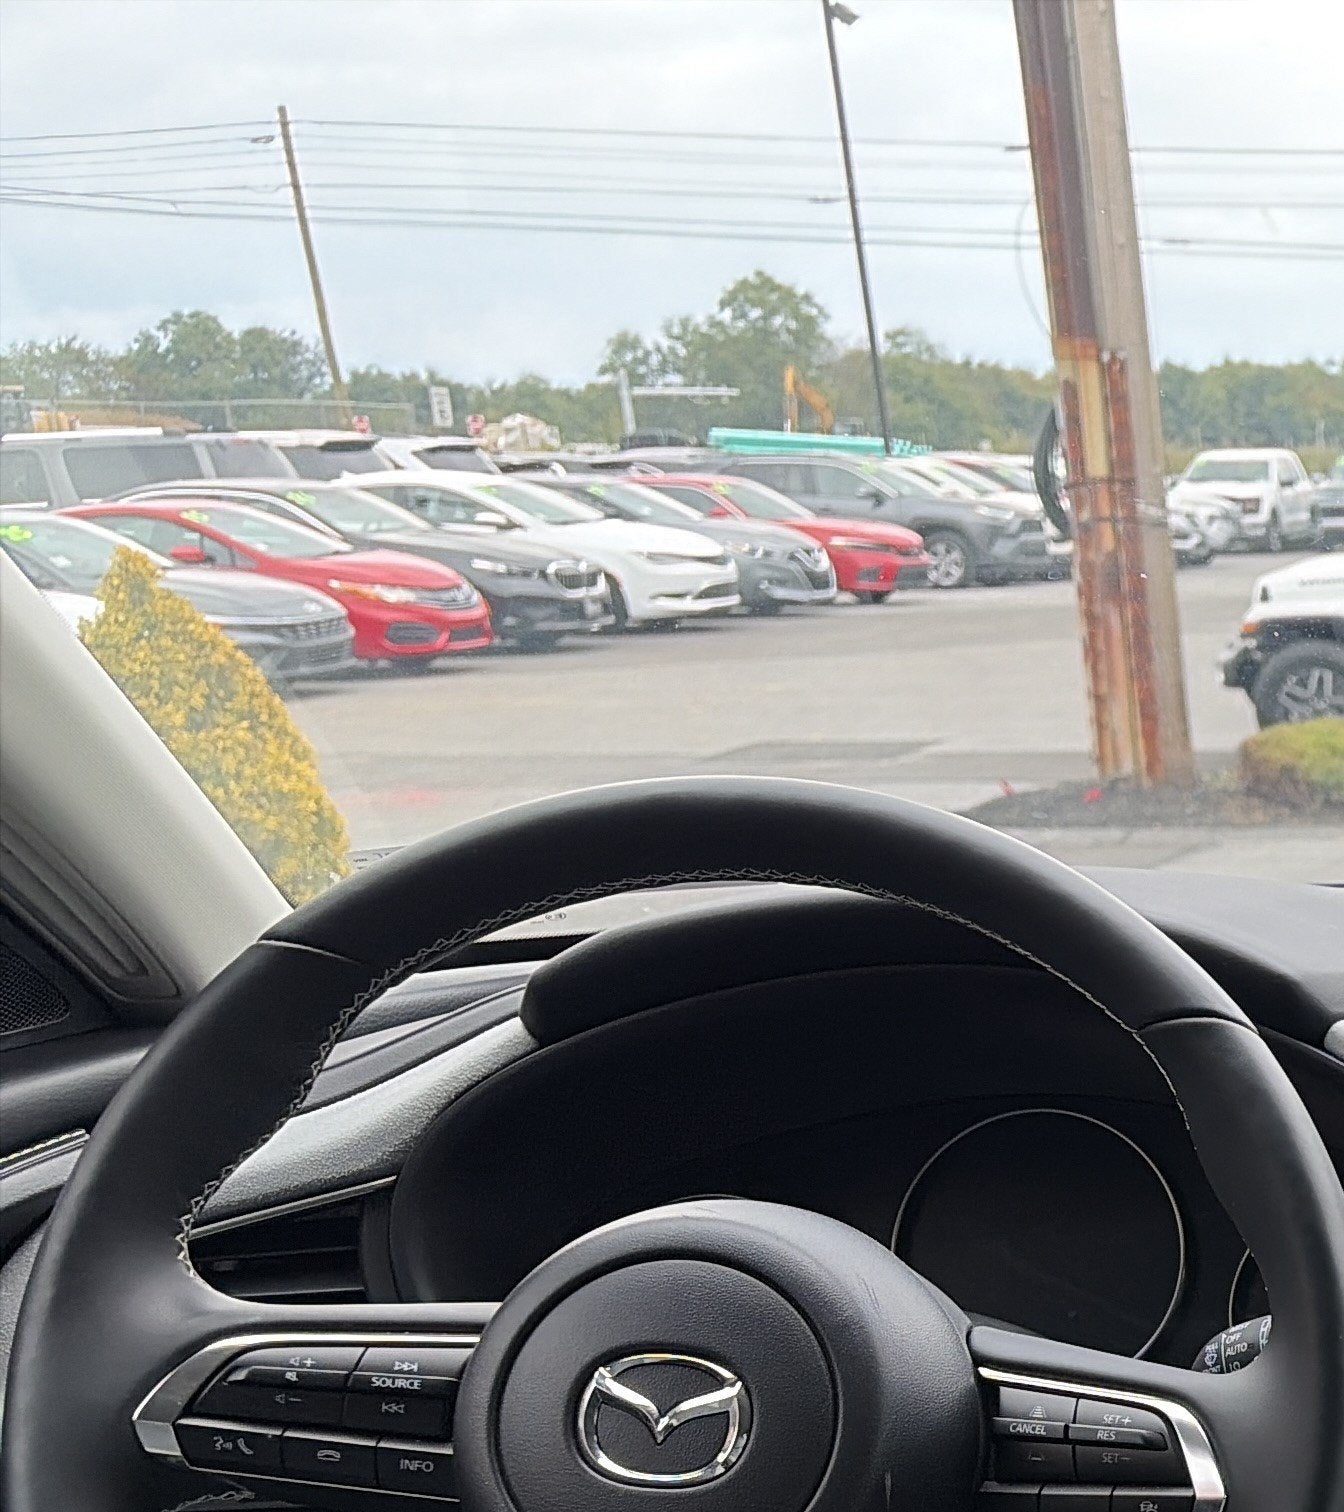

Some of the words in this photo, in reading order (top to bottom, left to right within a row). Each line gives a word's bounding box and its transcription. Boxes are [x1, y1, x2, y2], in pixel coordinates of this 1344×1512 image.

[1226, 1332, 1242, 1344] OFF
[1225, 1342, 1248, 1358] AUTO
[371, 1377, 422, 1389] SOURCE
[1009, 1423, 1046, 1436] CANCEL
[1096, 1430, 1116, 1441] RES
[399, 1459, 434, 1473] INFO
